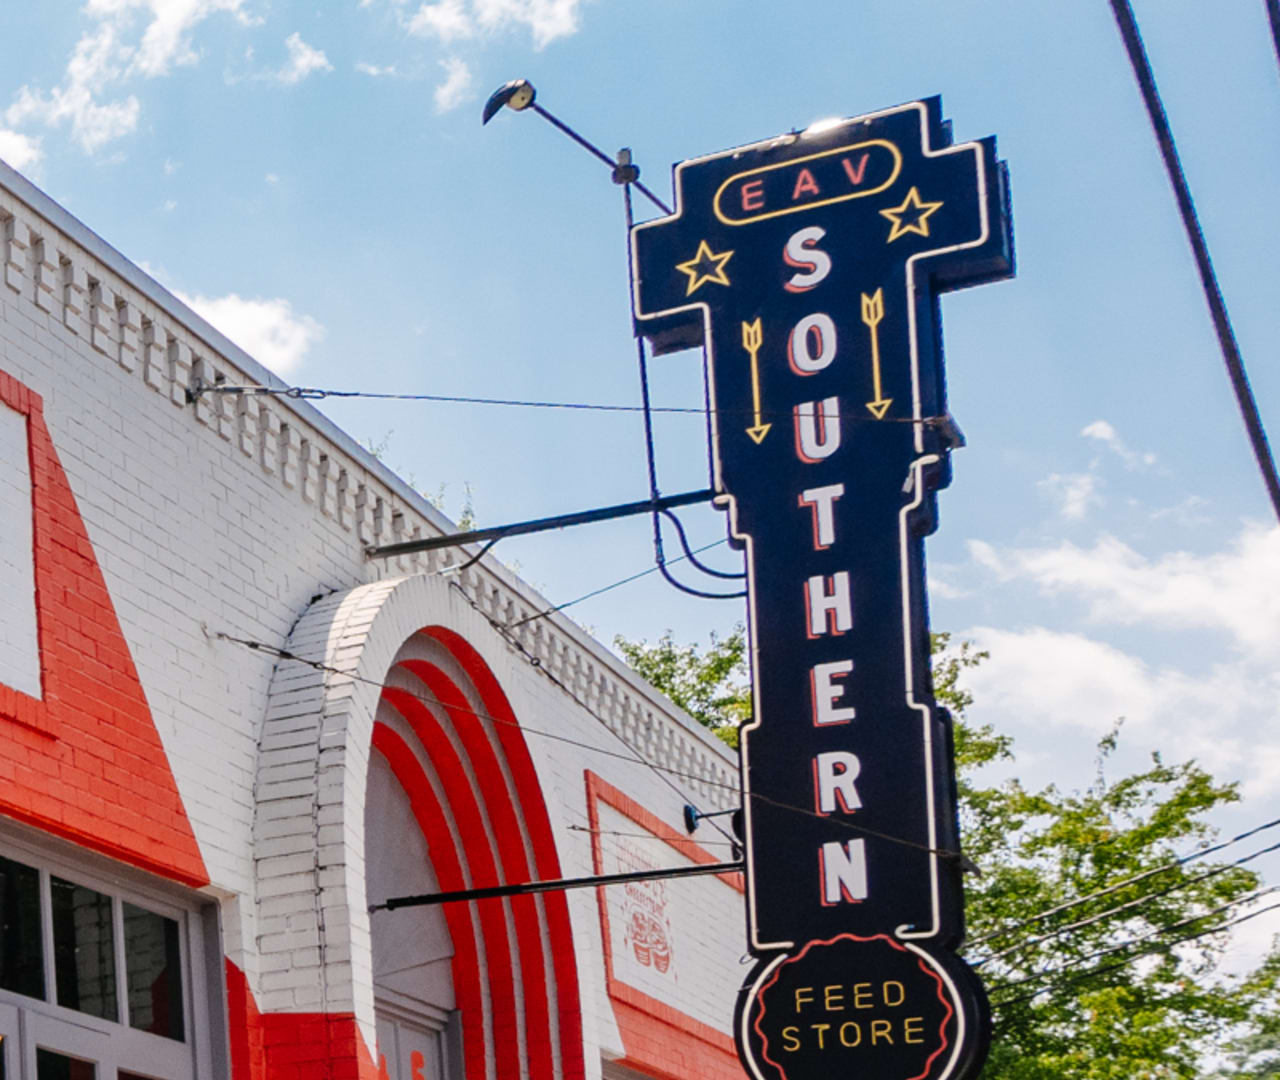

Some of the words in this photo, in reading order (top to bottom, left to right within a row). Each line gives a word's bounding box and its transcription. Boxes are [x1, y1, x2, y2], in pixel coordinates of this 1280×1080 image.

[741, 153, 870, 212] EAV
[784, 226, 868, 906] SOUTHERN
[794, 980, 906, 1013] FEED
[782, 1017, 925, 1052] STORE
